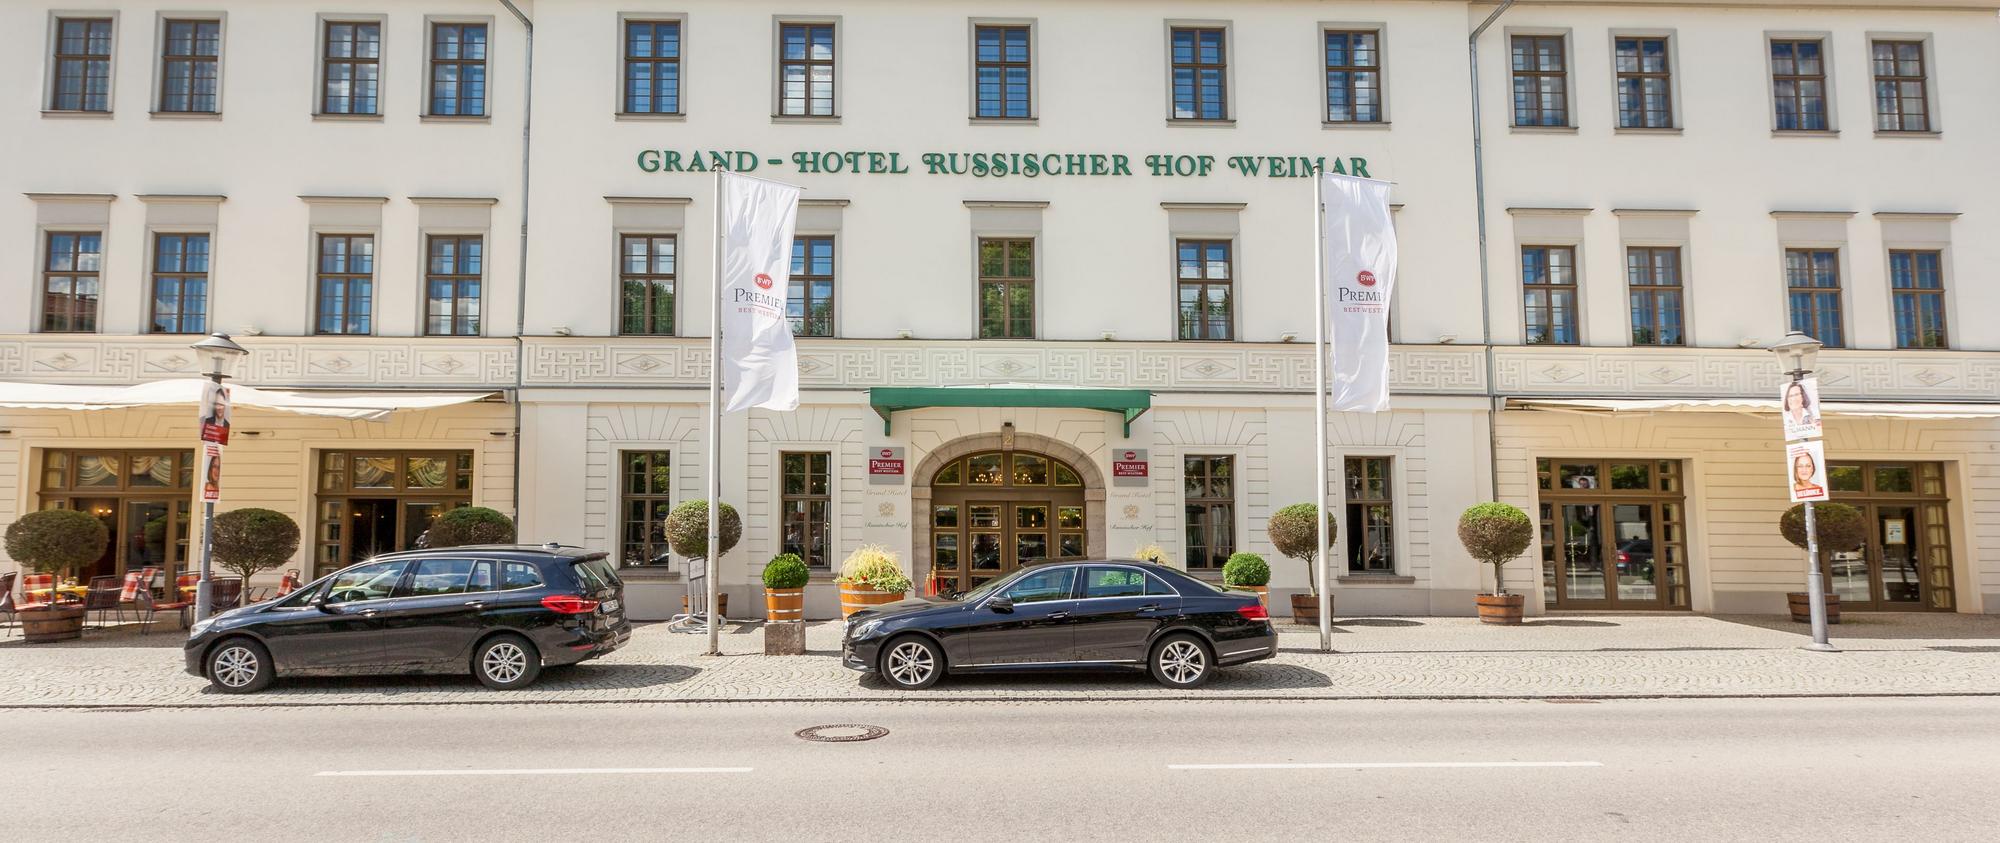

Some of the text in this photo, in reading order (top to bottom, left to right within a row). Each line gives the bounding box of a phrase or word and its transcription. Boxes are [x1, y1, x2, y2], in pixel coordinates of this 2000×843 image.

[637, 150, 759, 172] GRAND
[792, 151, 909, 174] HOTEL
[922, 152, 1133, 177] RUSSISCHER
[1145, 154, 1216, 177] HOF
[1228, 155, 1371, 178] WEIMAR
[734, 288, 784, 310] PREMIE
[872, 460, 902, 469] PREMIER
[1116, 463, 1146, 471] PREMIER
